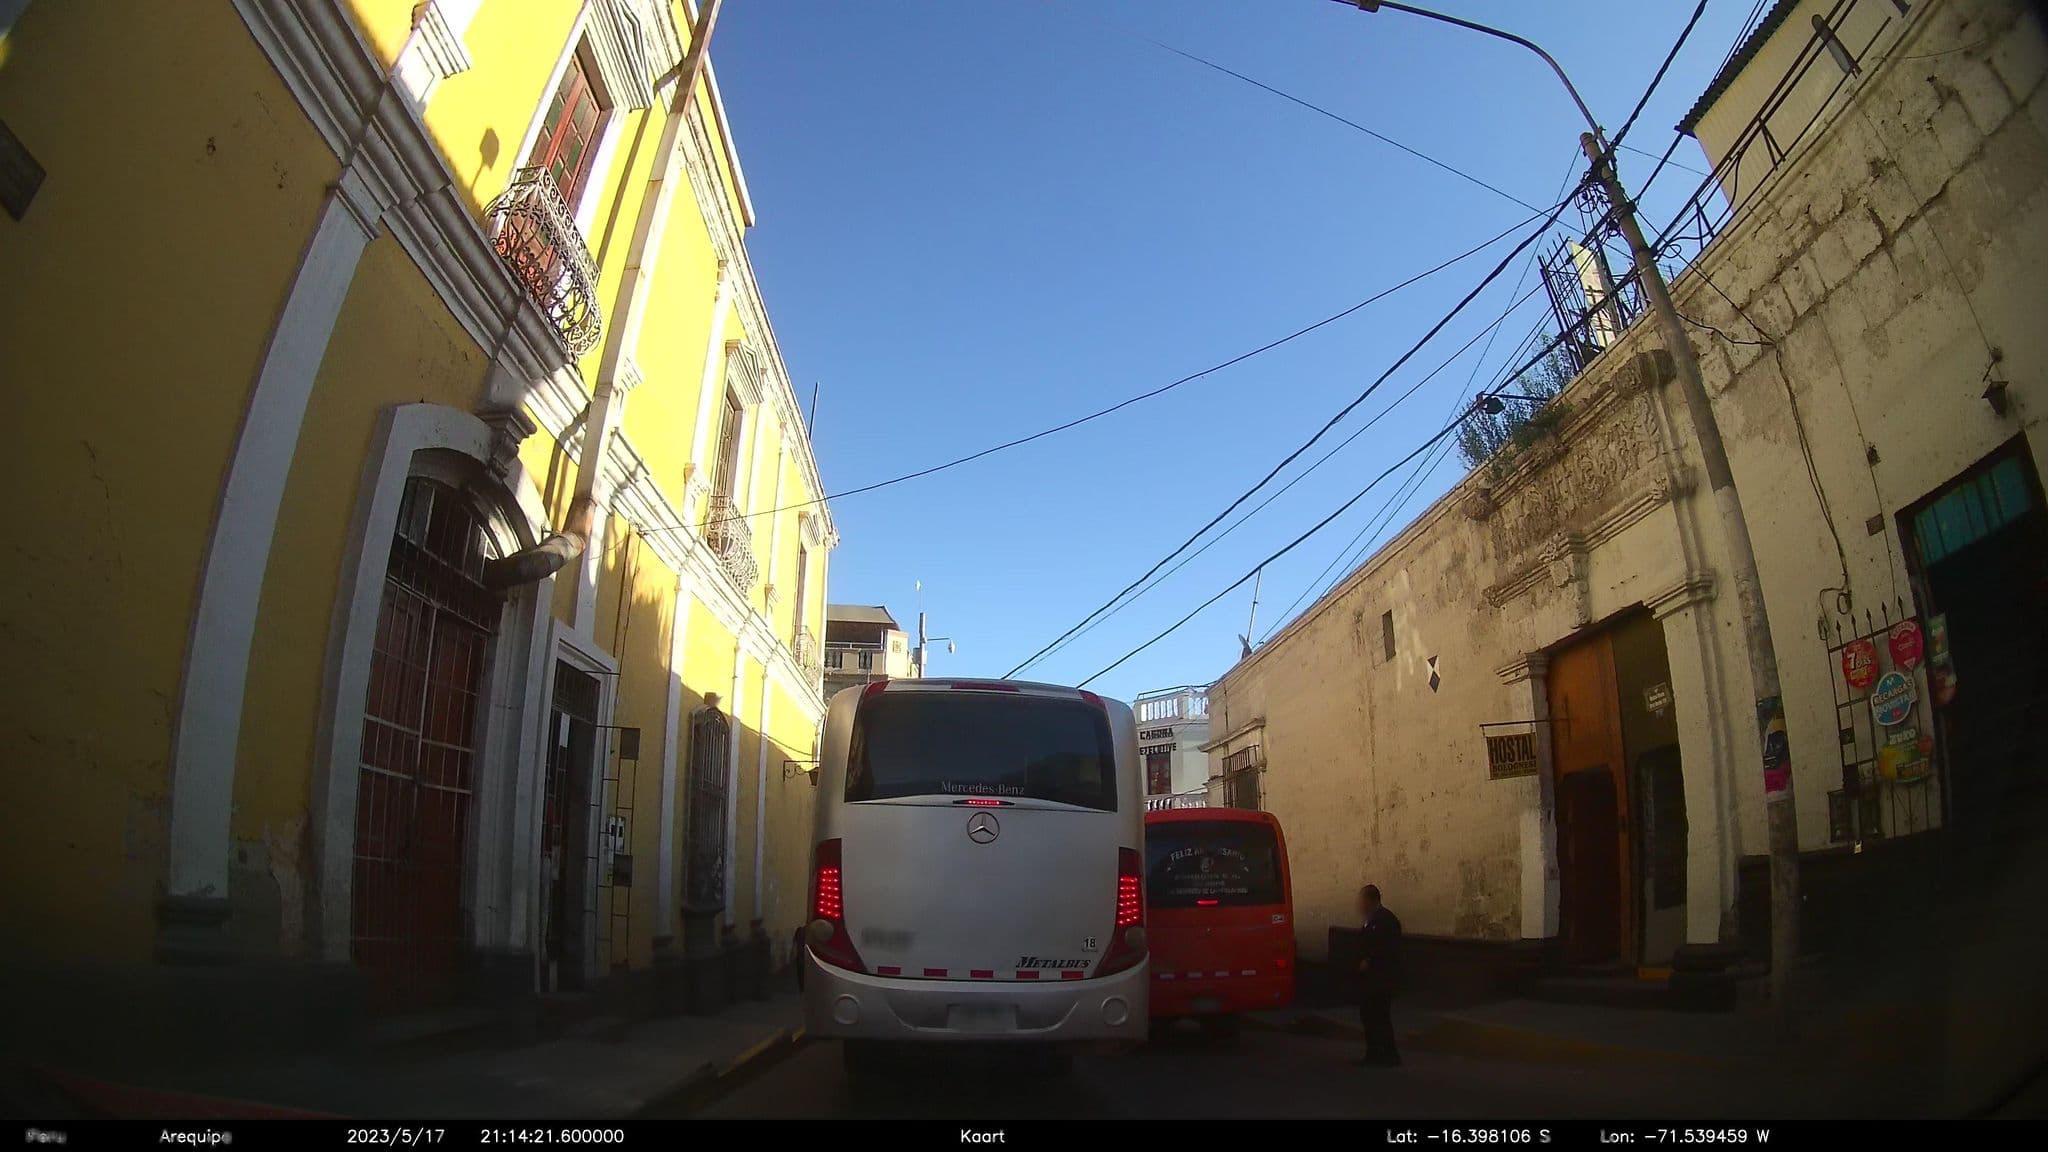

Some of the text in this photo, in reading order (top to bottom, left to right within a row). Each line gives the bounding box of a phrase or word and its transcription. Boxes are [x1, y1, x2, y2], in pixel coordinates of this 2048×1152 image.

[1487, 734, 1537, 764] HOSTAL
[1170, 848, 1193, 862] FELIZ
[1084, 938, 1097, 948] 18
